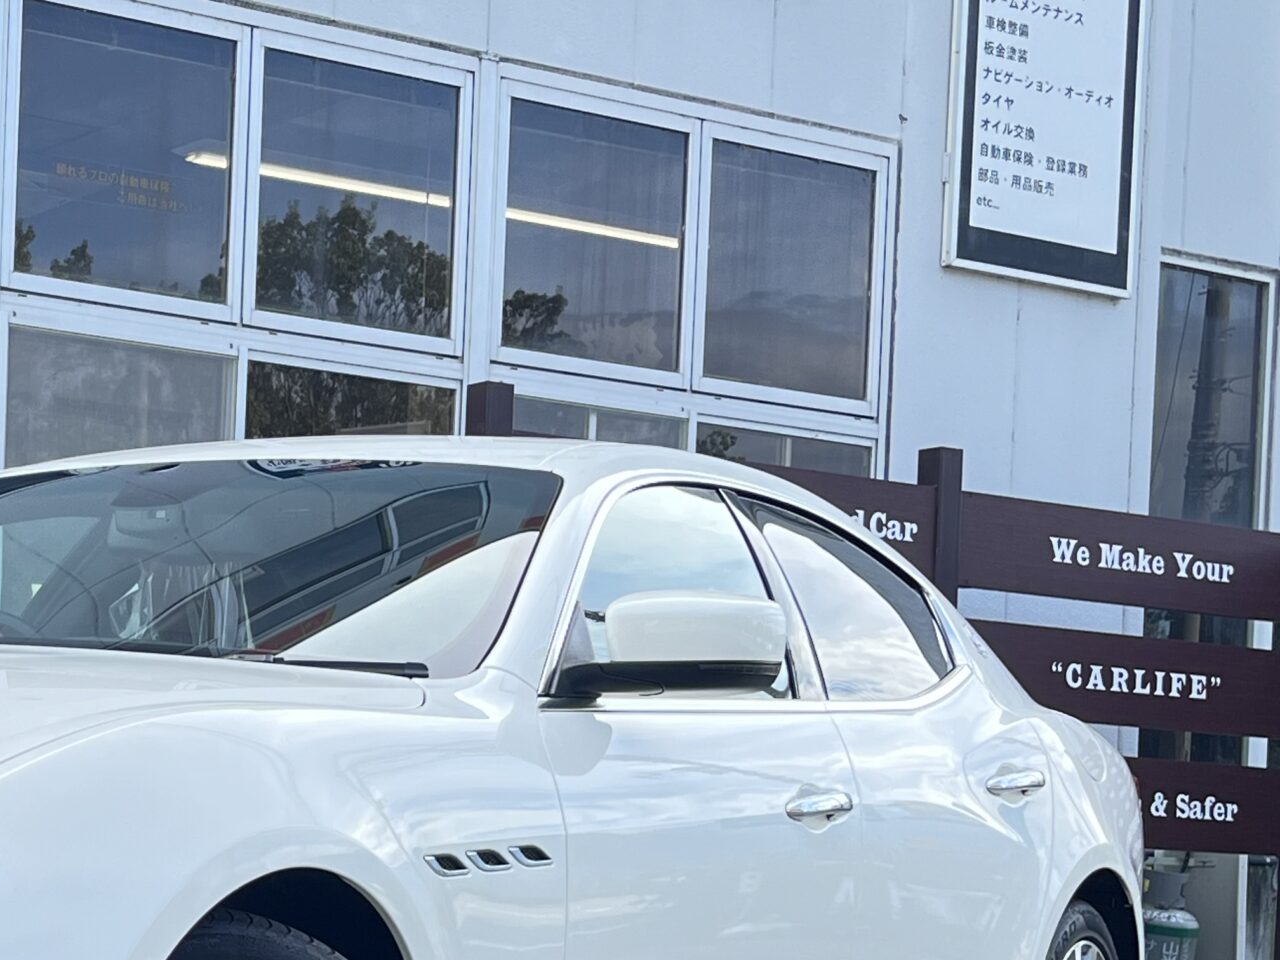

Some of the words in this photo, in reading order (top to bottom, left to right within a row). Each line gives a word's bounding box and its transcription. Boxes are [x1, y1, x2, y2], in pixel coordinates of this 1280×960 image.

[986, 0, 1083, 26] ムメンテナンス
[985, 15, 1029, 39] 車検整備
[984, 41, 1028, 64] 板金塗装
[982, 92, 1014, 110] タイヤ
[980, 117, 1035, 141] オイル交換
[870, 511, 918, 542] Car
[1049, 536, 1090, 566] We
[1098, 542, 1165, 575] Make
[1172, 552, 1234, 583] Your
[1150, 792, 1168, 817] &
[1176, 793, 1238, 822] Safer
